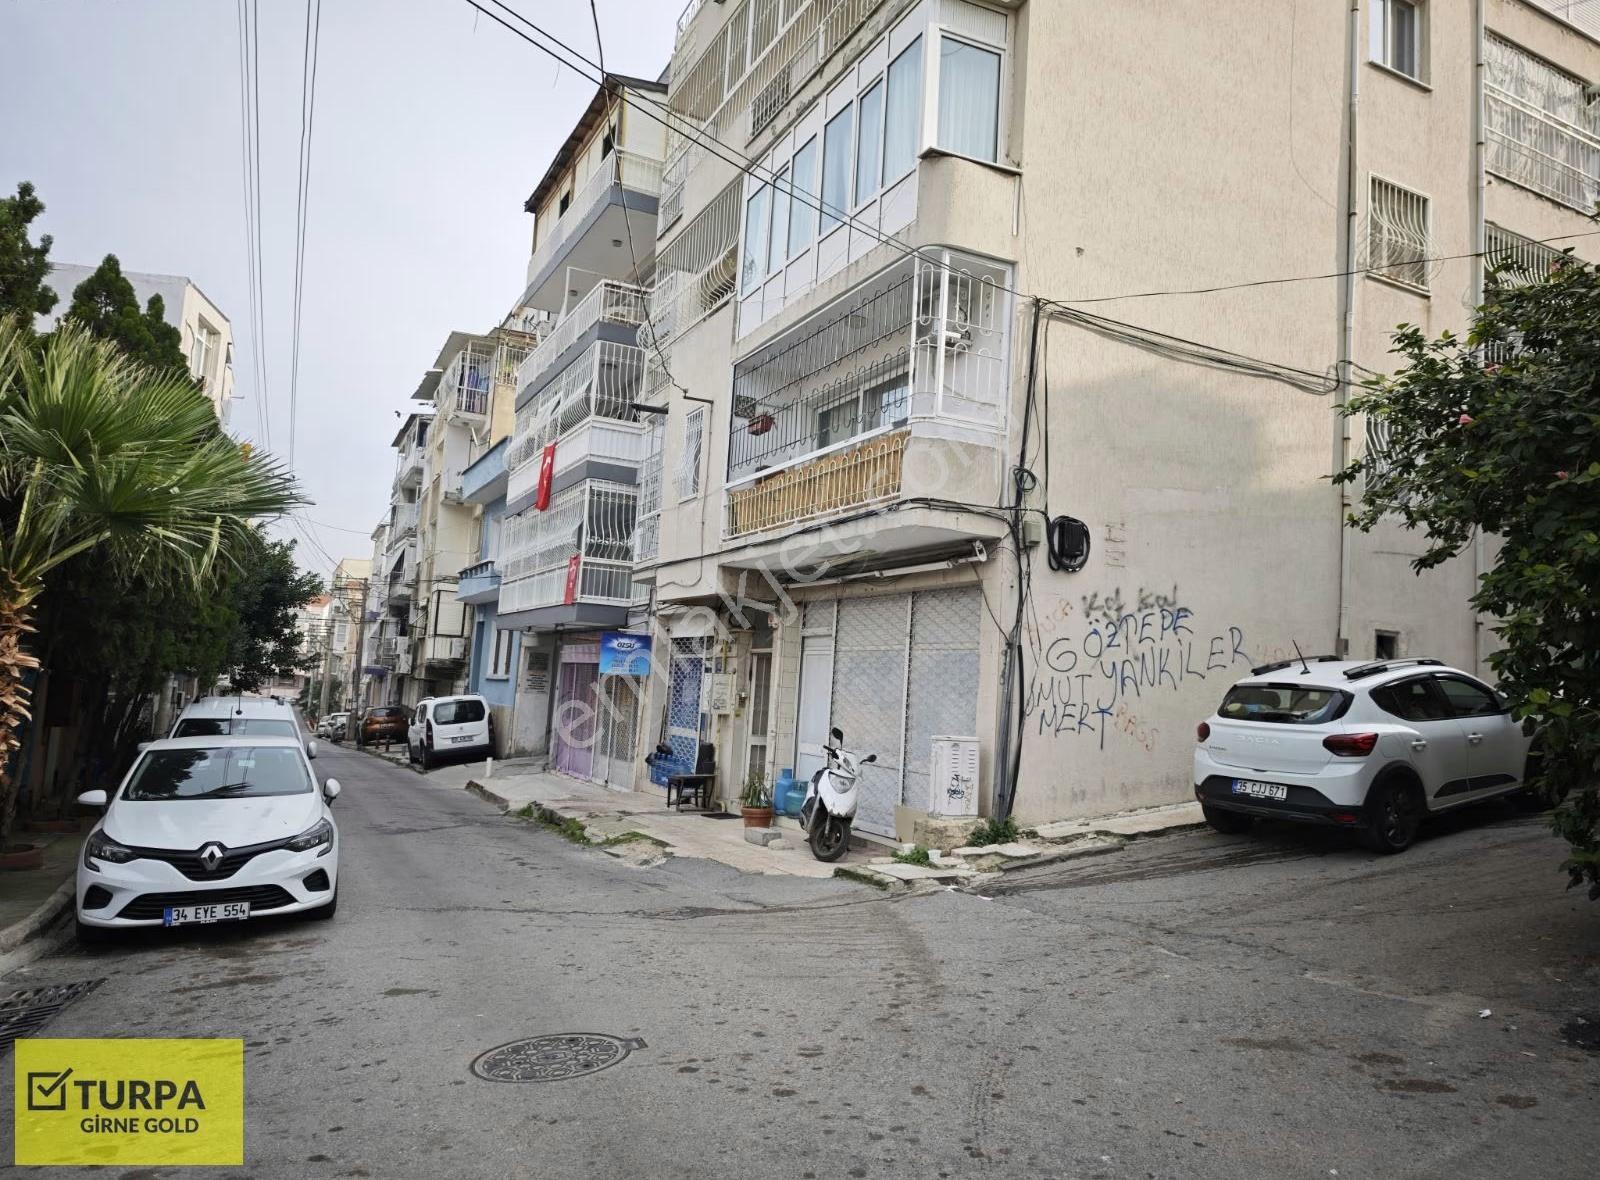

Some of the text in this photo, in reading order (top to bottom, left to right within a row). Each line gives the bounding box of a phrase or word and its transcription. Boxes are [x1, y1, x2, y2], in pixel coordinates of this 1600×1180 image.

[1039, 703, 1113, 750] MERT
[1237, 780, 1286, 797] 35 CJJ 671
[172, 904, 246, 921] 34 EYE 554
